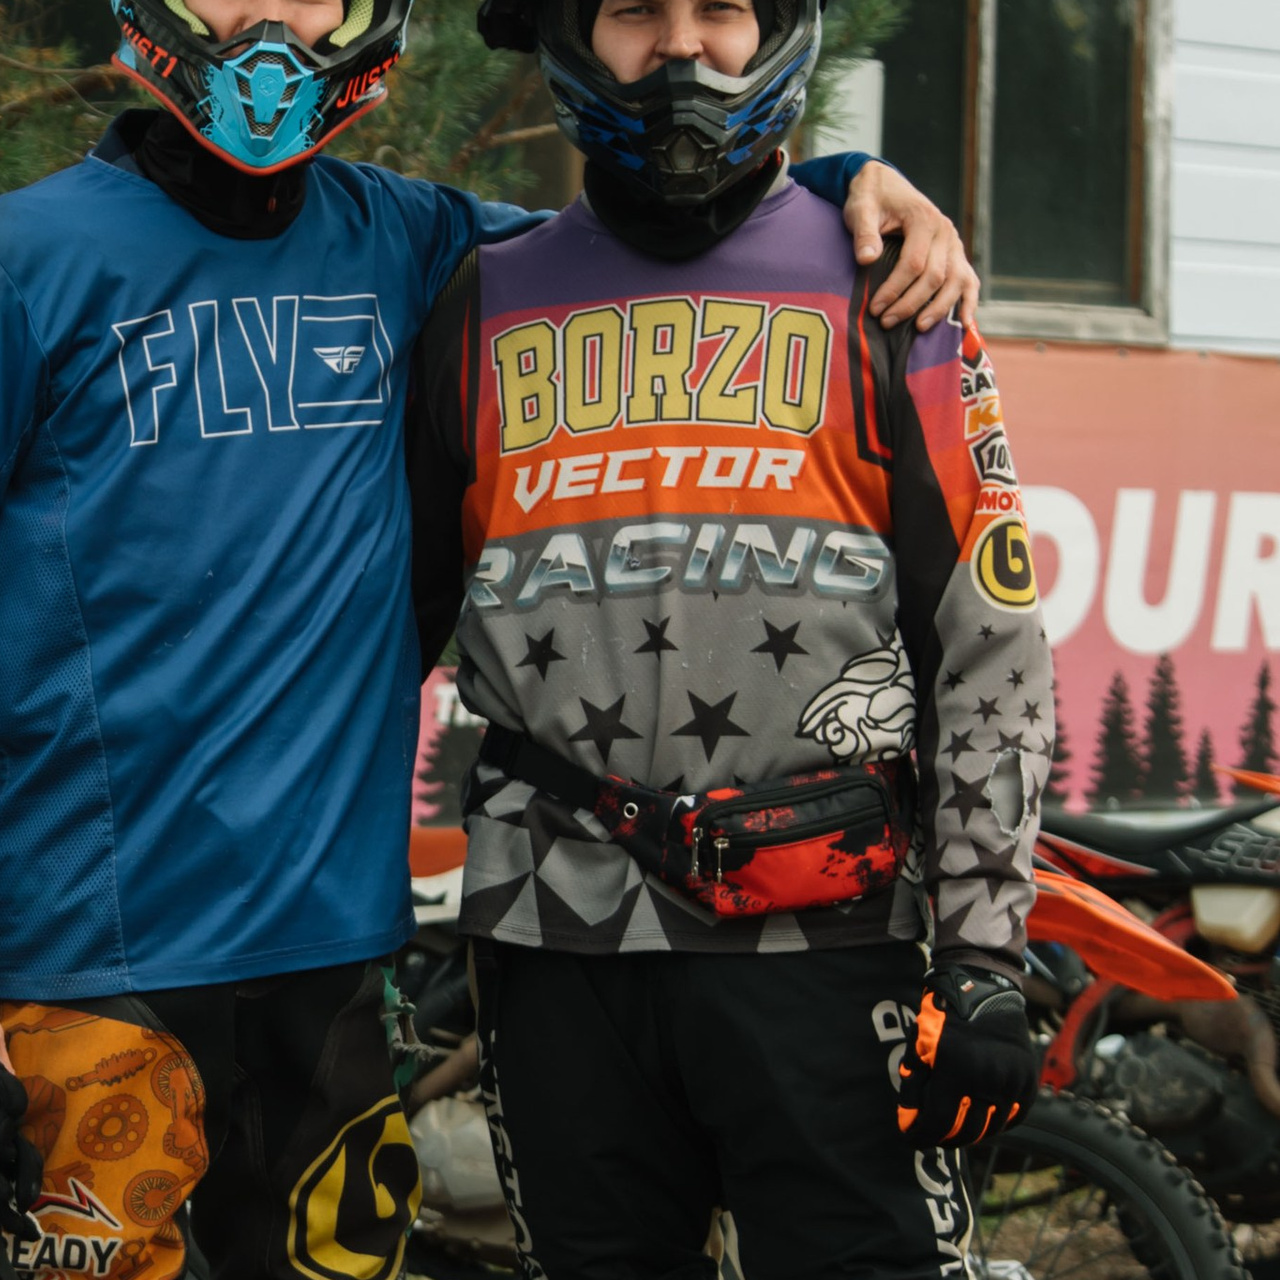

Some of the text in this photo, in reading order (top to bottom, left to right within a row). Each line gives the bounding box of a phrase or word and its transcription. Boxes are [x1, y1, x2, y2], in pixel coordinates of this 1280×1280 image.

[111, 294, 301, 448] FLY
[491, 295, 833, 458] BORZO
[513, 446, 806, 514] VECTOR
[463, 521, 892, 612] RACING
